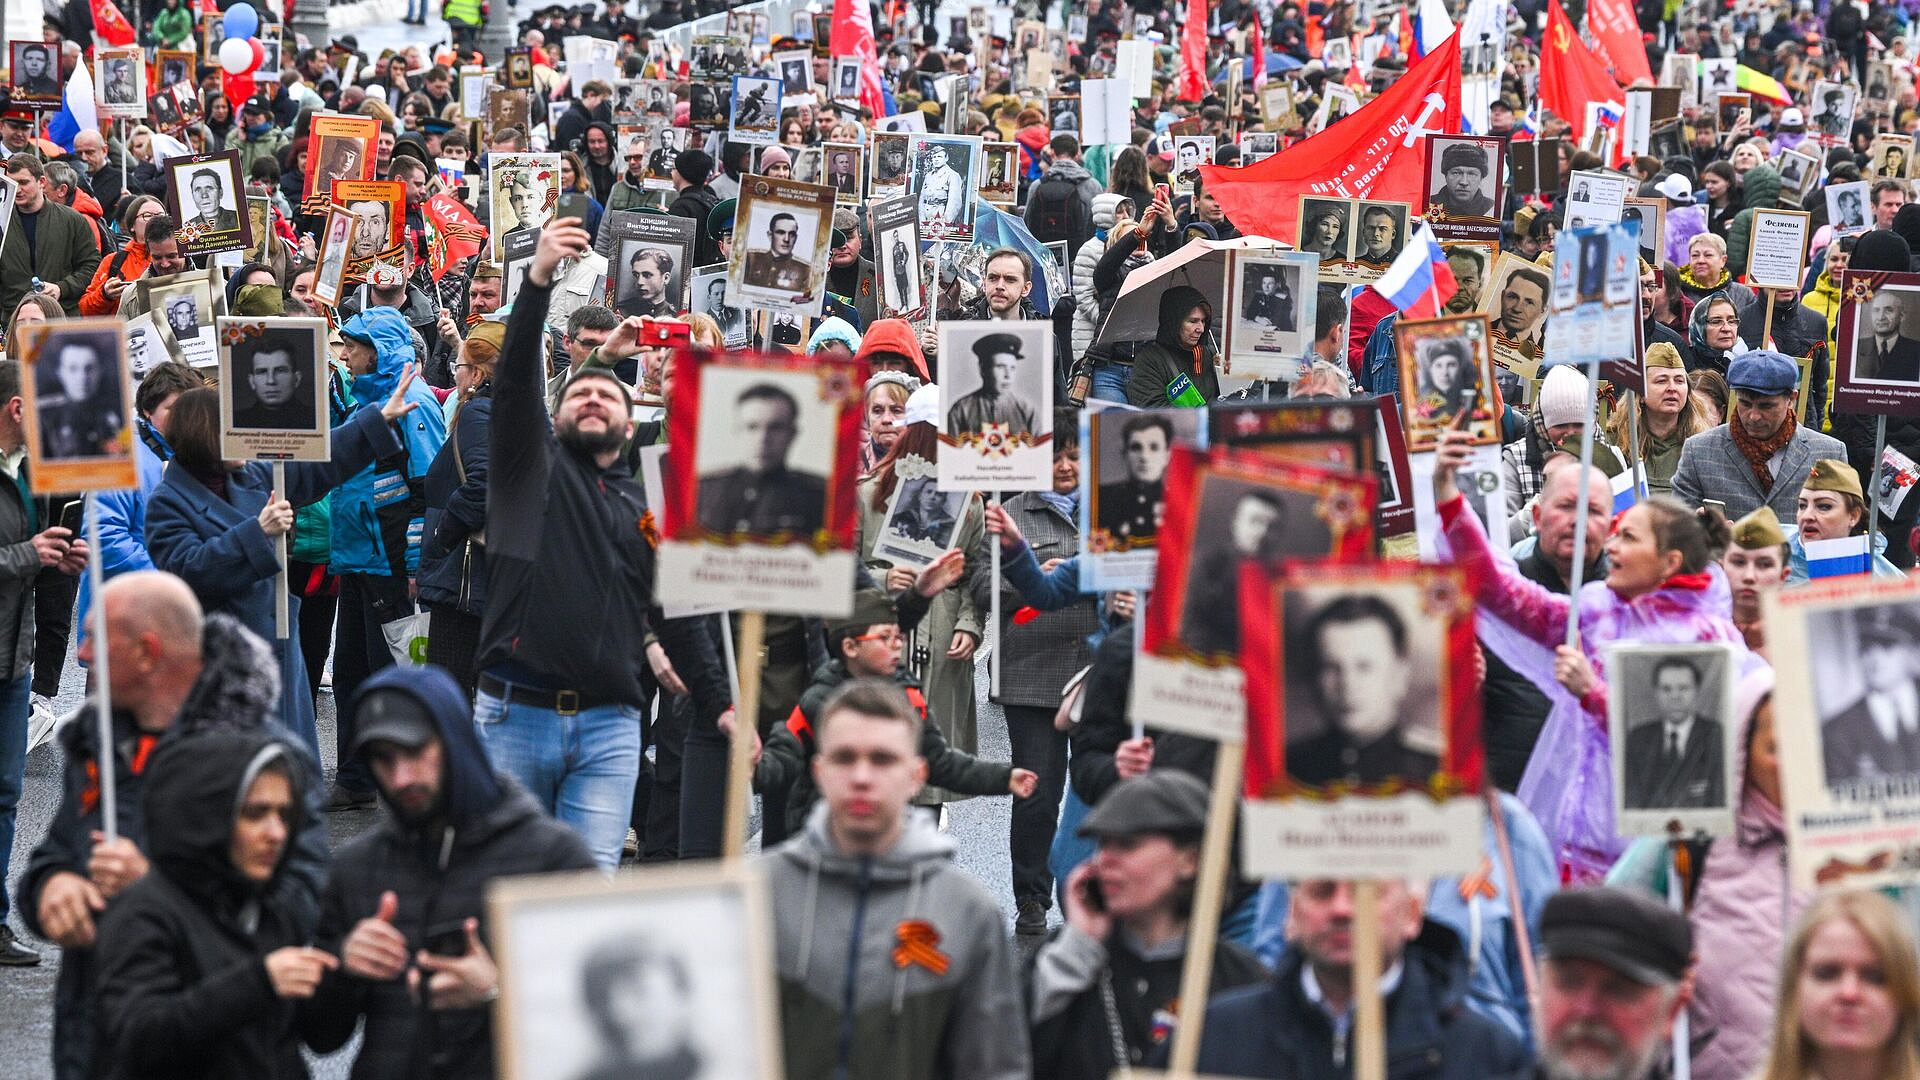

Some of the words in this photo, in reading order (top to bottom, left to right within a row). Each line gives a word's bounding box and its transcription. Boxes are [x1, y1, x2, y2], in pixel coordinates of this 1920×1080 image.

[640, 217, 669, 226] КЛИШИН
[626, 222, 650, 231] Виктор
[650, 224, 681, 233] Иванович
[187, 243, 205, 251] Иван
[204, 239, 241, 250] Данилович
